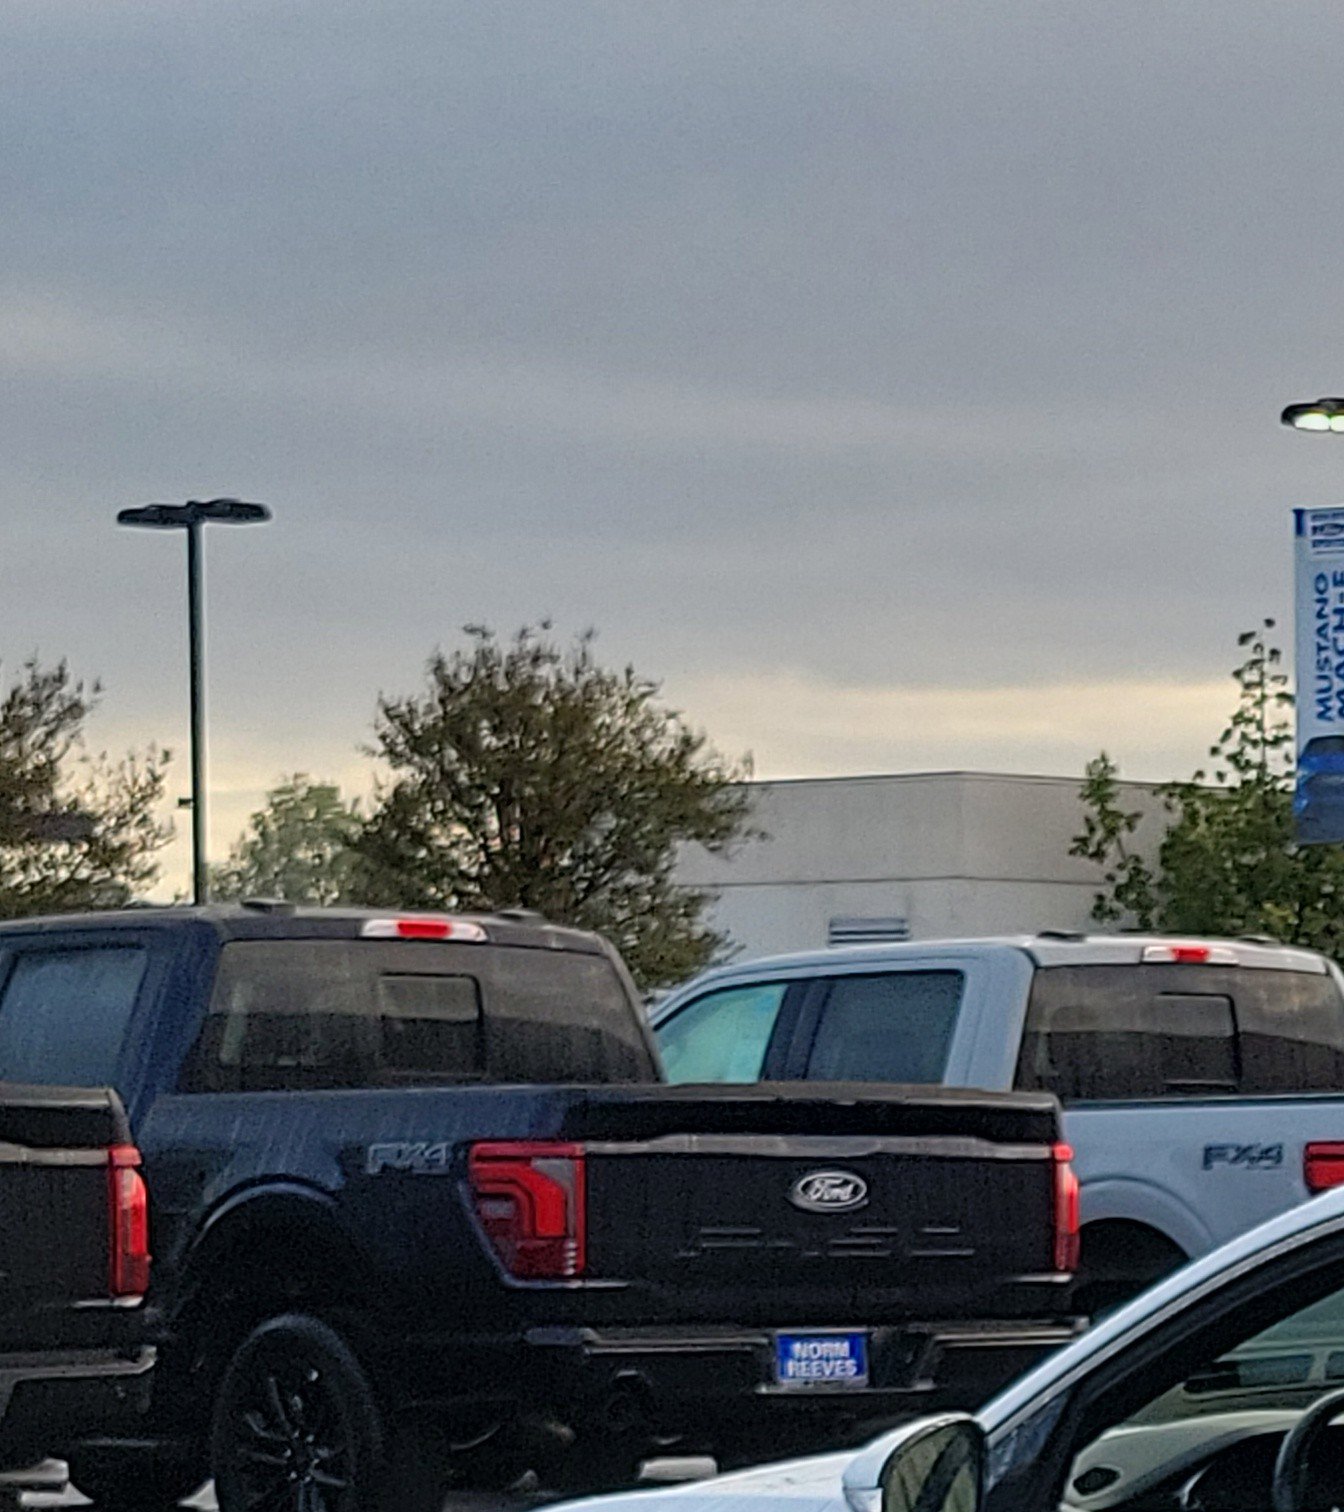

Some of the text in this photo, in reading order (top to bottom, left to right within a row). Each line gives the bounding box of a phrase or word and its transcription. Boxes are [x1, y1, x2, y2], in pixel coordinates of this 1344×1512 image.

[1314, 572, 1334, 722] MUSTANG
[1202, 1143, 1284, 1171] FX4
[801, 1175, 861, 1203] Ford
[791, 1341, 850, 1360] NORM
[787, 1359, 858, 1378] REEVES
